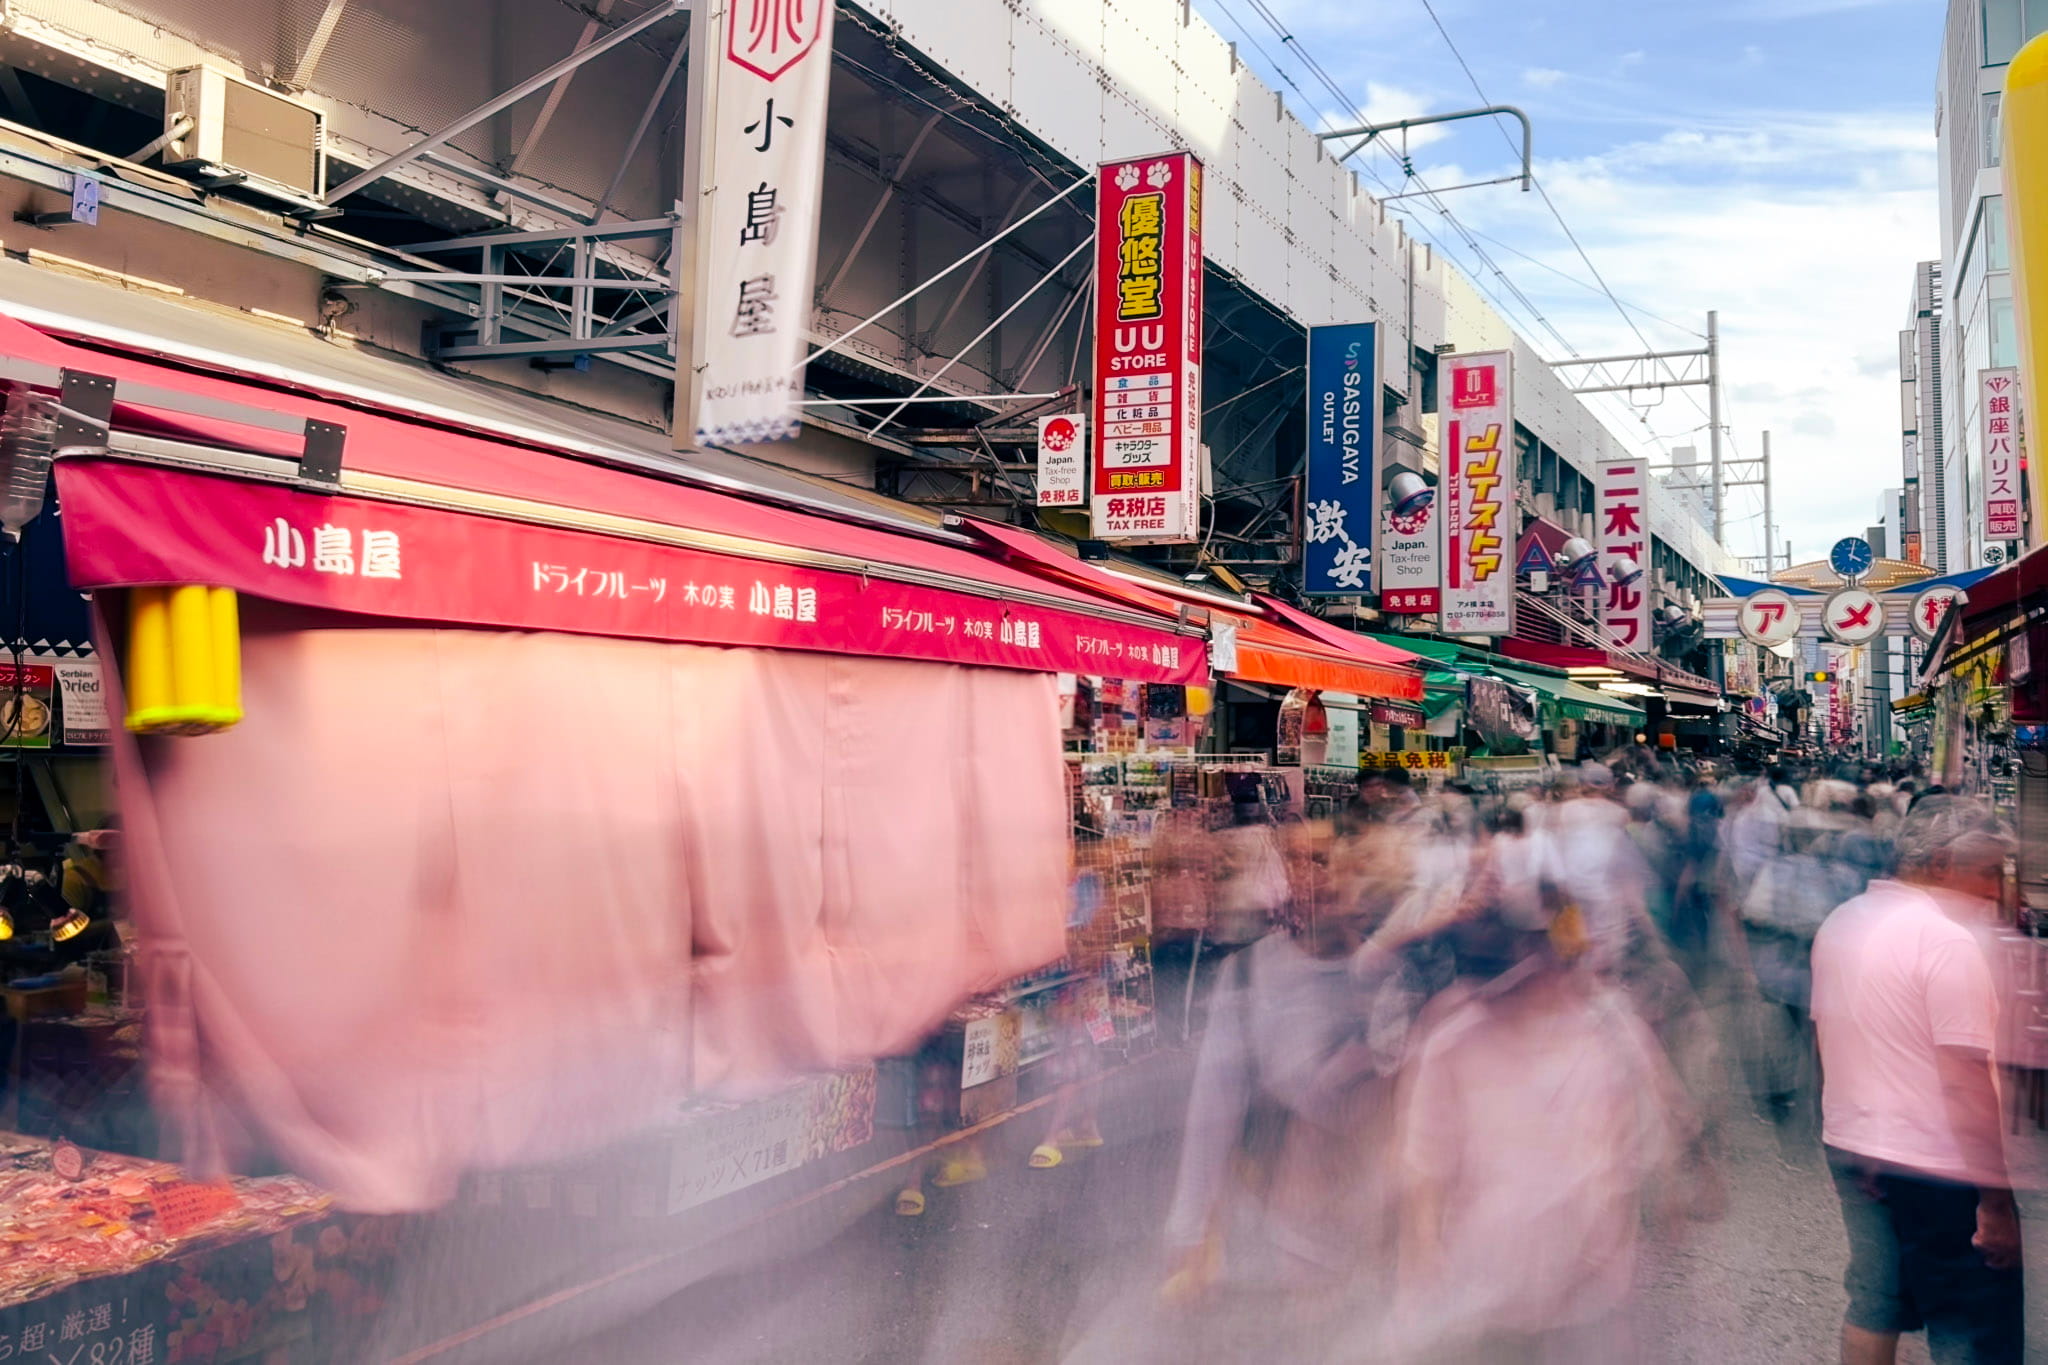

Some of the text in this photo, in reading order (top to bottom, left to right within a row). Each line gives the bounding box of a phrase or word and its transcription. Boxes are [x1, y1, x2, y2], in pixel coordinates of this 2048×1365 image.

[728, 97, 795, 337] 小島屋
[1119, 193, 1162, 319] 優悠堂
[1114, 324, 1164, 352] UU
[1111, 353, 1167, 371] STORE
[1117, 406, 1159, 420] 化粧品
[1323, 391, 1335, 445] OUTLET
[1112, 422, 1162, 435] ベビー用品
[1342, 371, 1361, 485] SASUGAYA
[1115, 439, 1159, 452] キャラクター
[1988, 395, 2012, 495] 銀座パリス
[1122, 452, 1151, 464] グッズ
[1044, 466, 1077, 476] Tax-free
[1049, 477, 1071, 486] Shop
[1040, 489, 1079, 503] 免税店
[1106, 496, 1165, 518] 免税店
[1989, 503, 2016, 515] 買取
[1107, 518, 1165, 531] TAX FREE
[1989, 520, 2017, 533] 販売
[262, 516, 402, 580] 小島屋
[1305, 499, 1371, 589] 激安
[1390, 553, 1431, 563] Tax-free
[1396, 565, 1423, 575] Shop
[532, 560, 818, 623] ドライフルーツ 木の実 小島屋
[1389, 594, 1433, 607] 免税店
[881, 606, 1041, 649] ドライフルーツ 木の実 小島屋
[1076, 634, 1179, 670] ドライフルーツ 木の実 小島屋
[60, 670, 93, 678] Serbian
[1361, 751, 1447, 769] 全品免税
